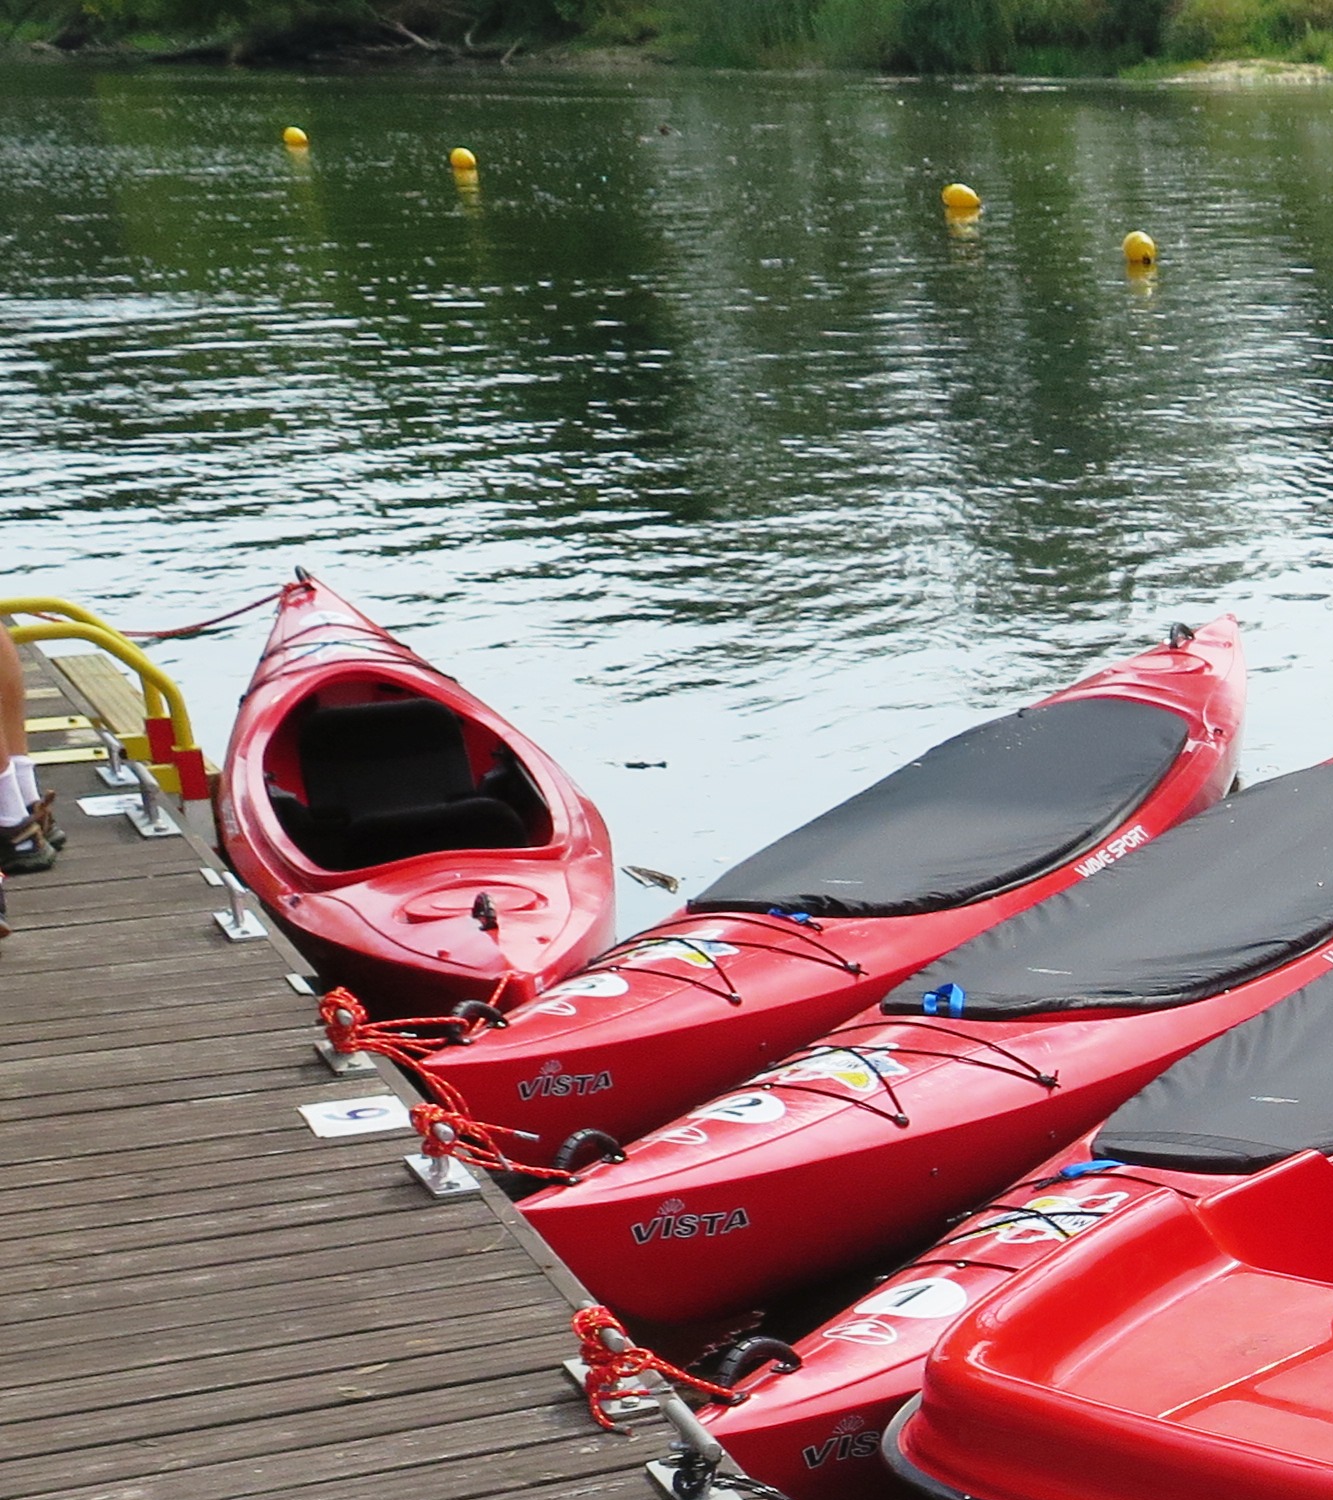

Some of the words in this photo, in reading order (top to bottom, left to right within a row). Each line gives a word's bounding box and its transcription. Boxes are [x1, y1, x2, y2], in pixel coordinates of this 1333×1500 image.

[1074, 849, 1115, 878] WAVE
[1106, 824, 1149, 859] SPORT
[517, 1070, 613, 1101] VISTA
[630, 1207, 750, 1245] VISTA
[889, 1284, 936, 1308] 1
[802, 1431, 881, 1470] VIS
